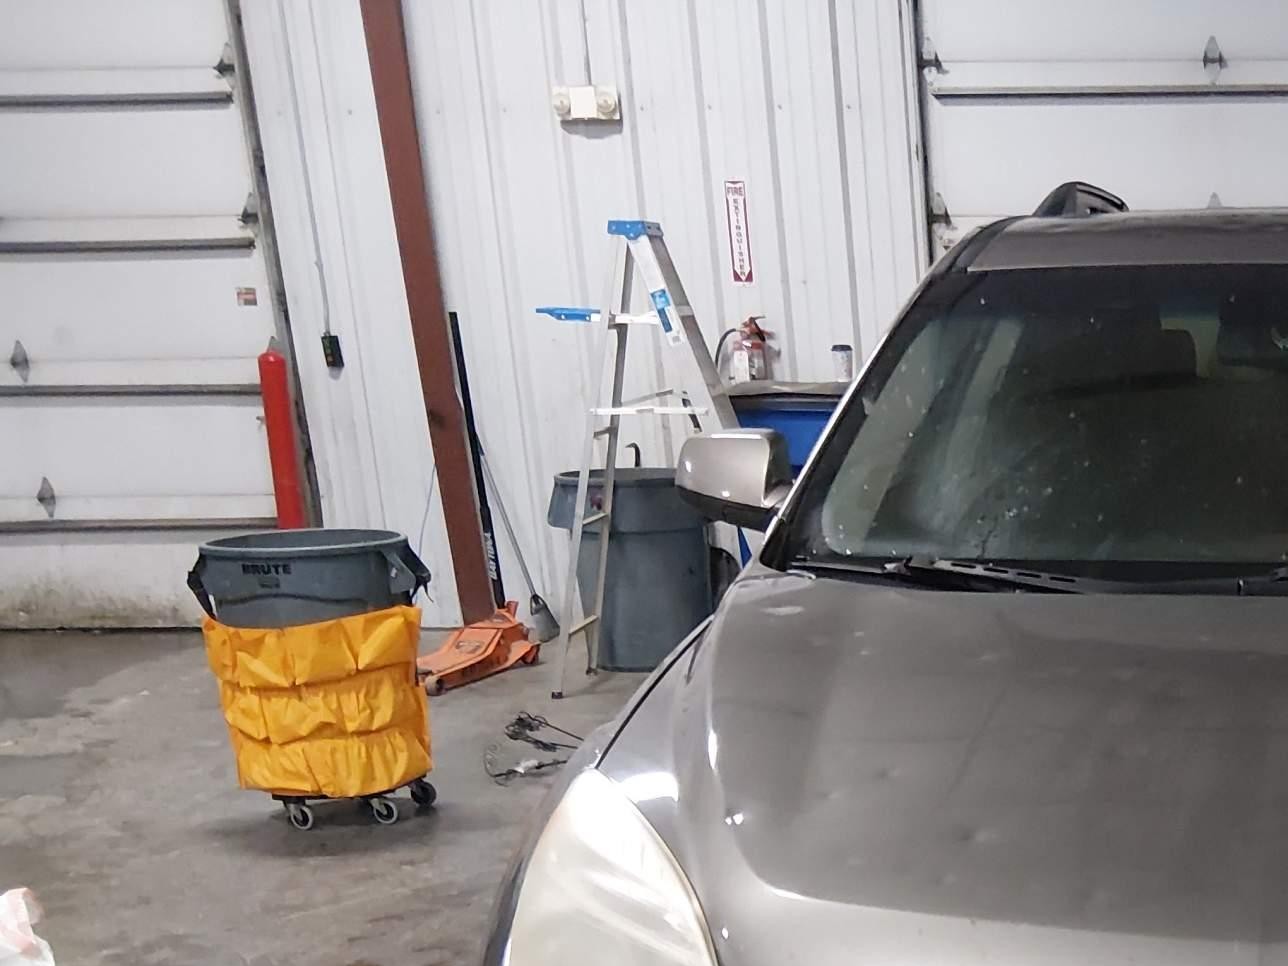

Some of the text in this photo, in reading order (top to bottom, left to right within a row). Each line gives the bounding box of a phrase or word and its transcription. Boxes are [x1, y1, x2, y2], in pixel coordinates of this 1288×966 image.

[726, 186, 744, 197] FIRE
[732, 198, 746, 277] EXTINGUISHER
[241, 562, 292, 576] BRUTE
